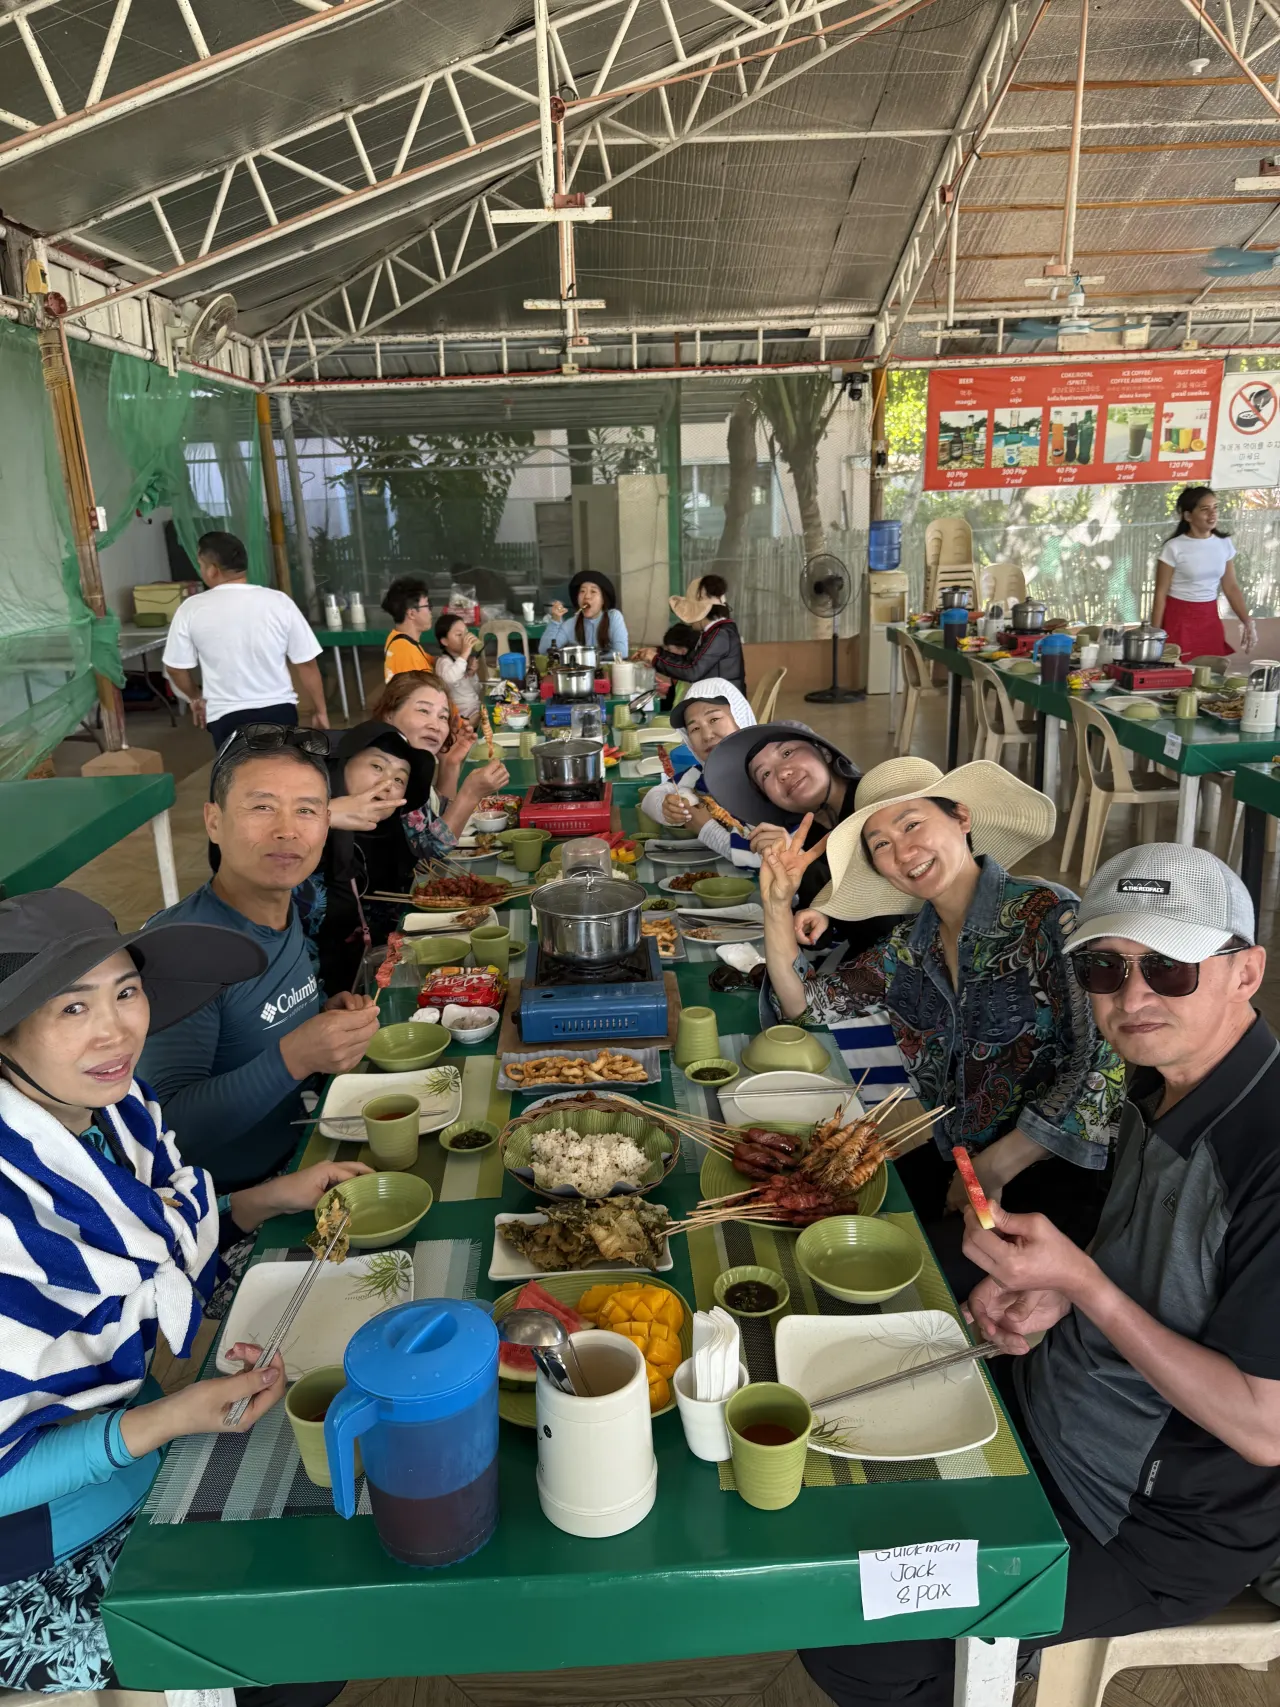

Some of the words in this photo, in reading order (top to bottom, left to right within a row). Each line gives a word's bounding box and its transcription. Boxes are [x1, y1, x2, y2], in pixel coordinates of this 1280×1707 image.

[1125, 464, 1137, 472] Php
[1181, 461, 1194, 469] Php
[956, 471, 969, 479] Php
[890, 1559, 937, 1583] Jack
[896, 1585, 911, 1604] 8
[916, 1583, 952, 1609] pax
